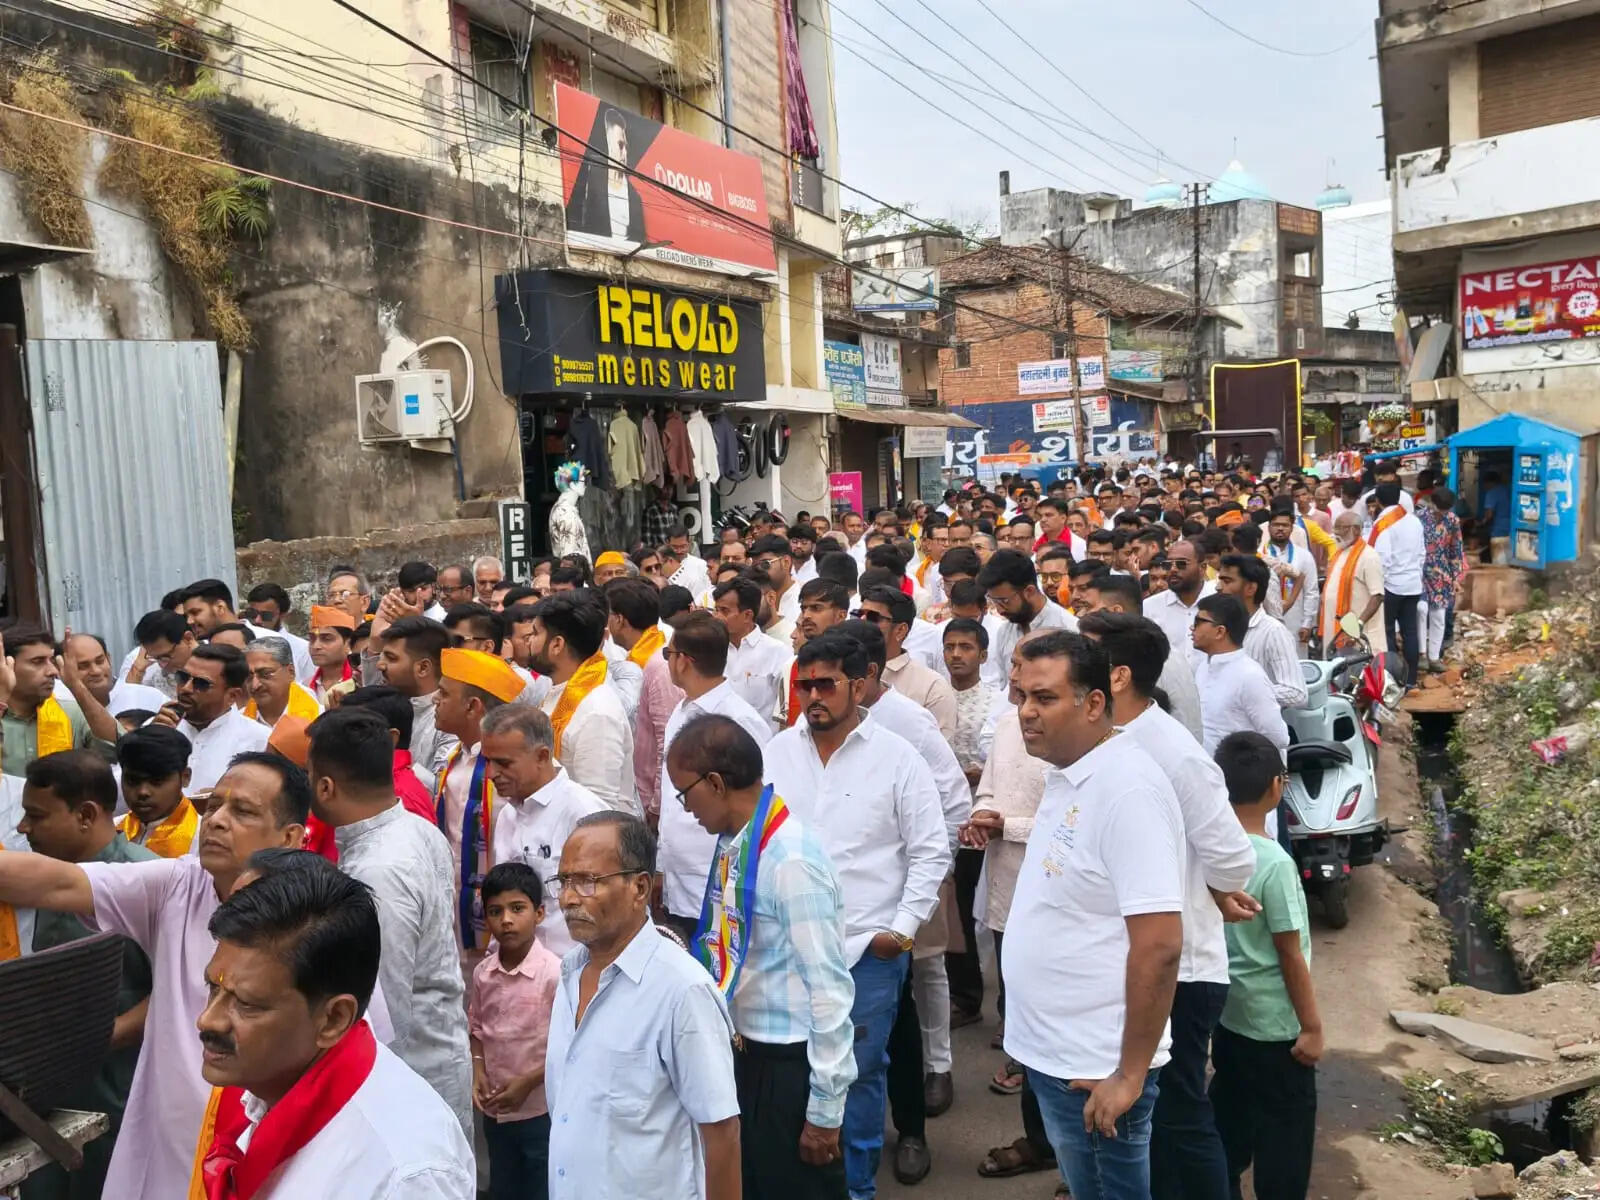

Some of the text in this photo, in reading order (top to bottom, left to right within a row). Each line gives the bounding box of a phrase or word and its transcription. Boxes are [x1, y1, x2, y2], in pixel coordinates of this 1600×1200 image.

[666, 169, 713, 202] DOLLAR
[656, 249, 714, 268] RELOAD MENS WEAR
[598, 284, 739, 354] RELOAD
[598, 353, 737, 391] mens wear
